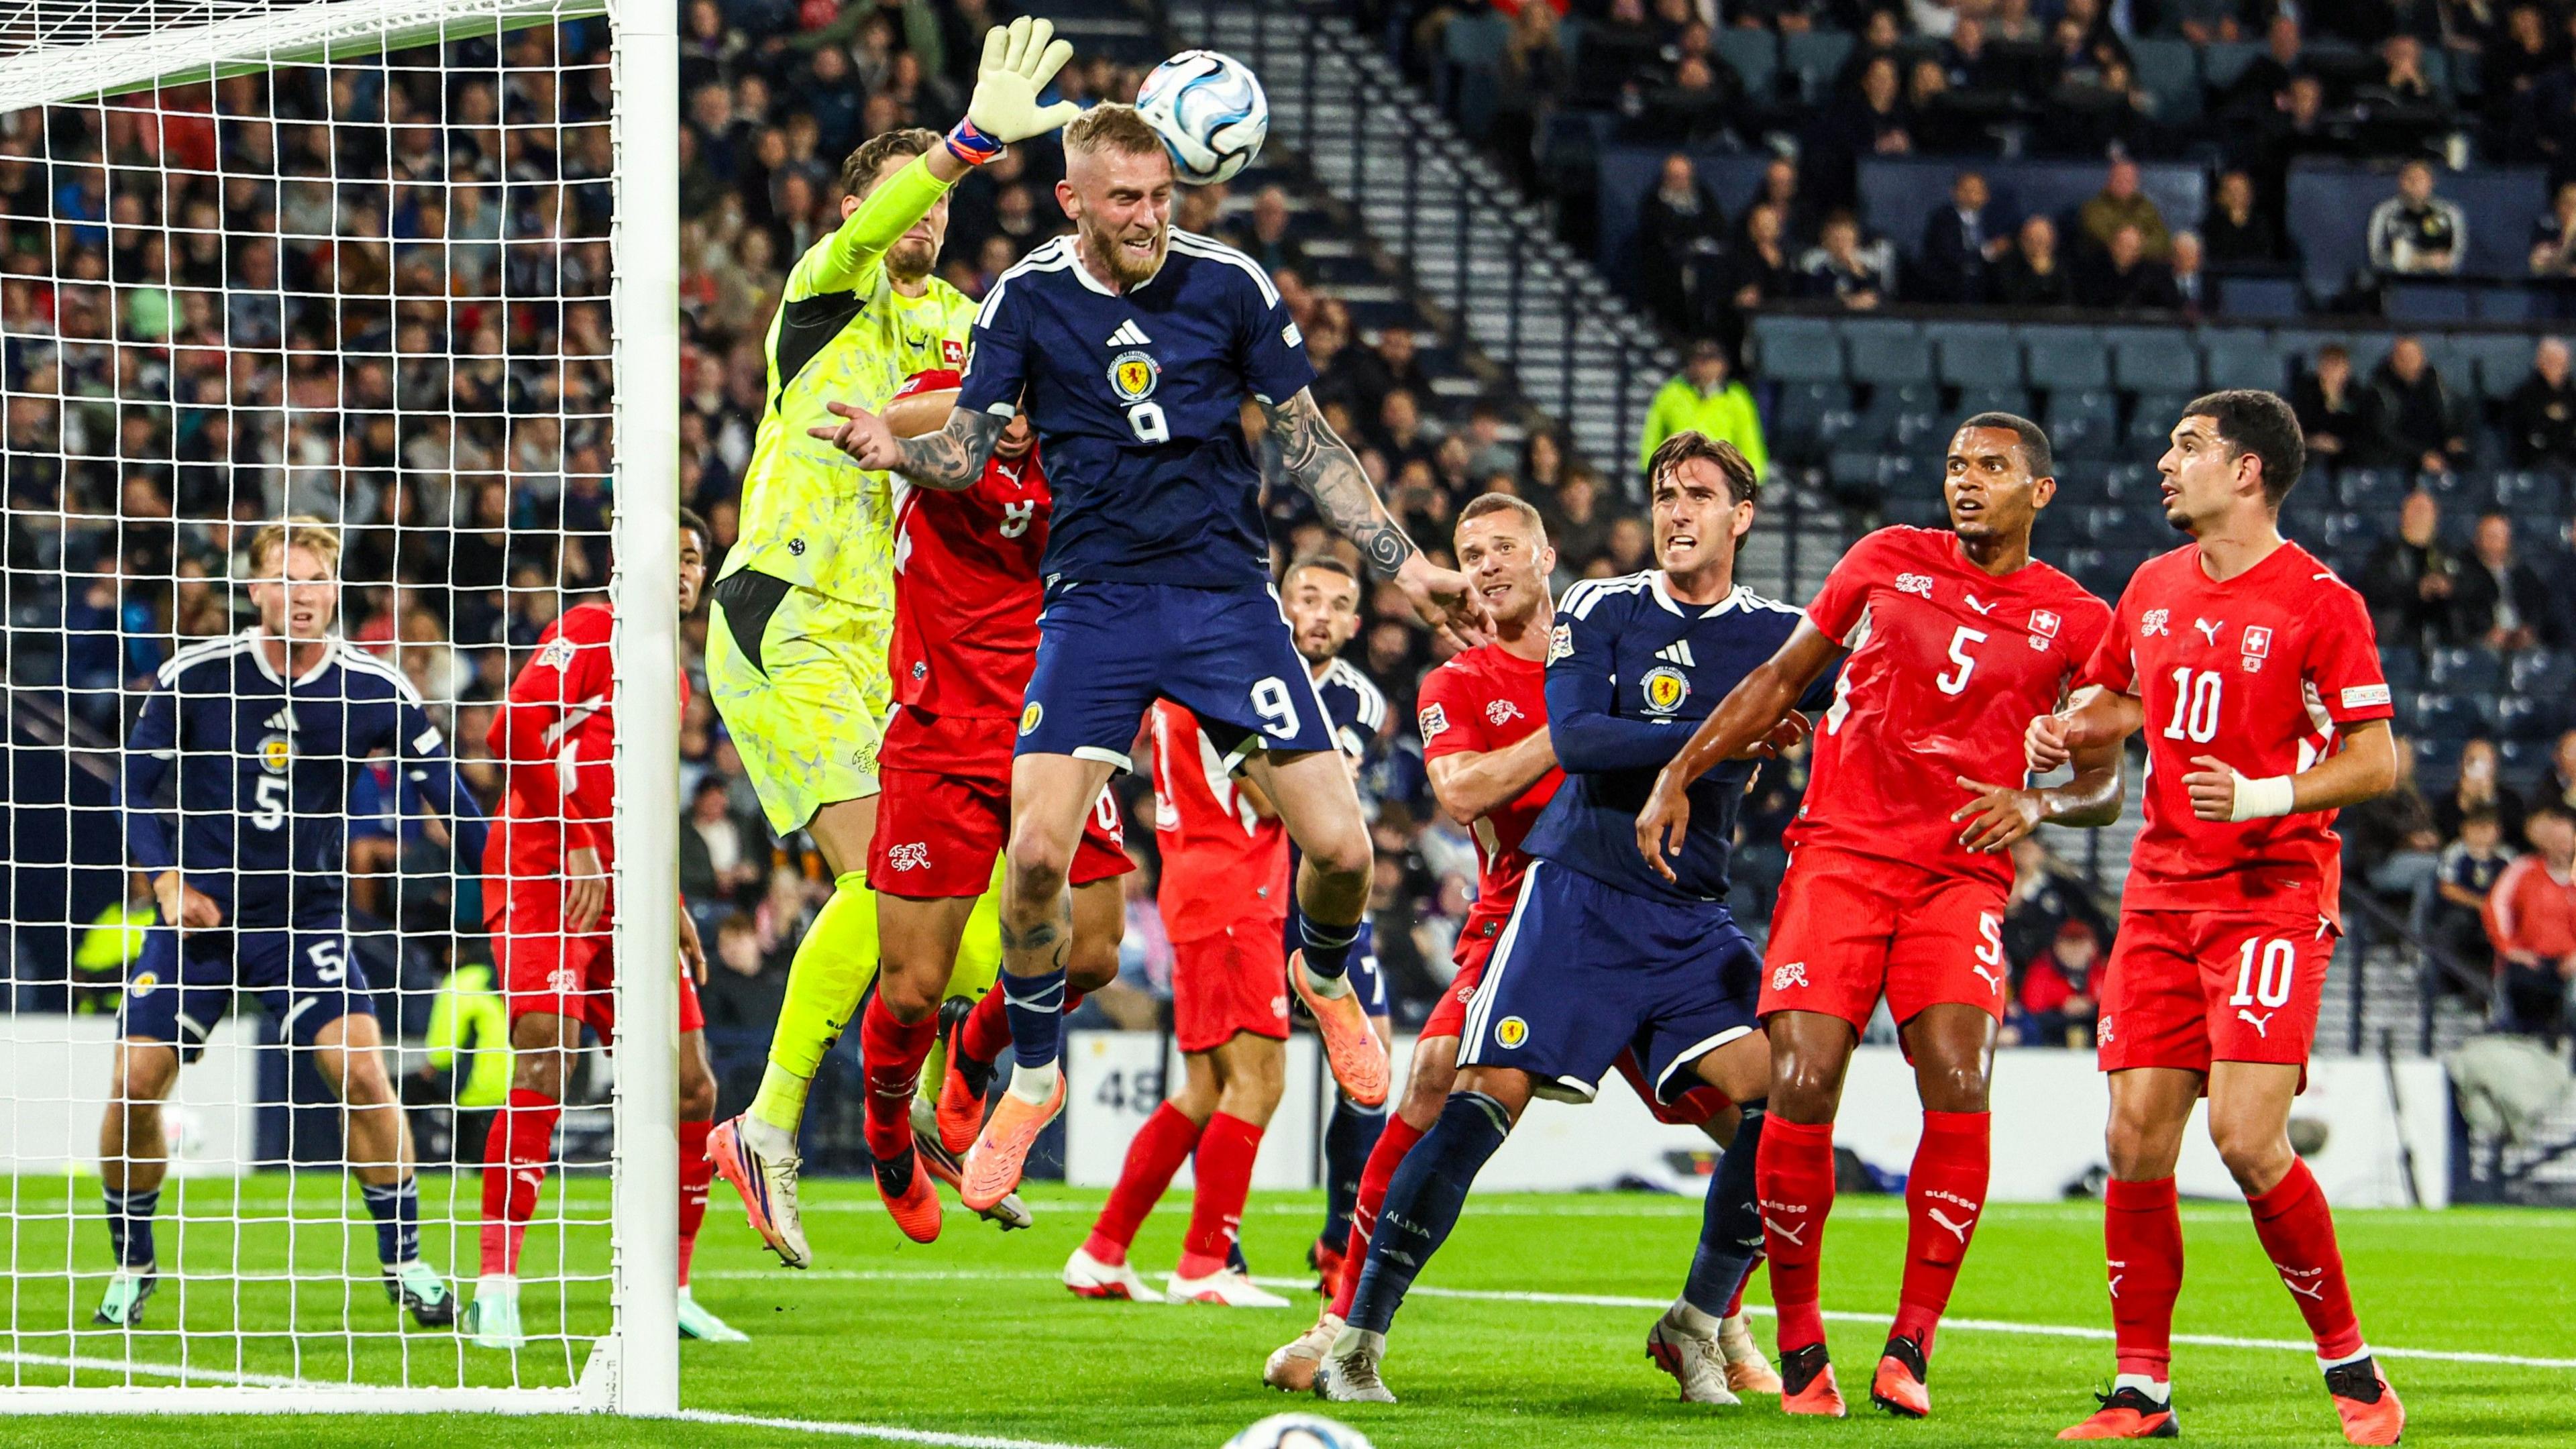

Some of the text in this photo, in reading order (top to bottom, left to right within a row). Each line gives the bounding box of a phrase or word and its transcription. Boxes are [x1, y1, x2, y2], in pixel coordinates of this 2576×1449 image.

[1127, 402, 1170, 444] 9
[1000, 499, 1034, 539] 8
[1936, 625, 1988, 696] 5
[1250, 676, 1301, 741] 9
[2163, 666, 2222, 743] 10
[251, 775, 288, 831] 5
[307, 940, 345, 983] 5
[1975, 911, 2000, 966] 5
[1360, 955, 1385, 1005] 7
[2229, 936, 2295, 1008] 10
[1385, 1210, 1431, 1239] ALBA
[1760, 1198, 1808, 1214] suisse
[1924, 1189, 1978, 1212] suisse
